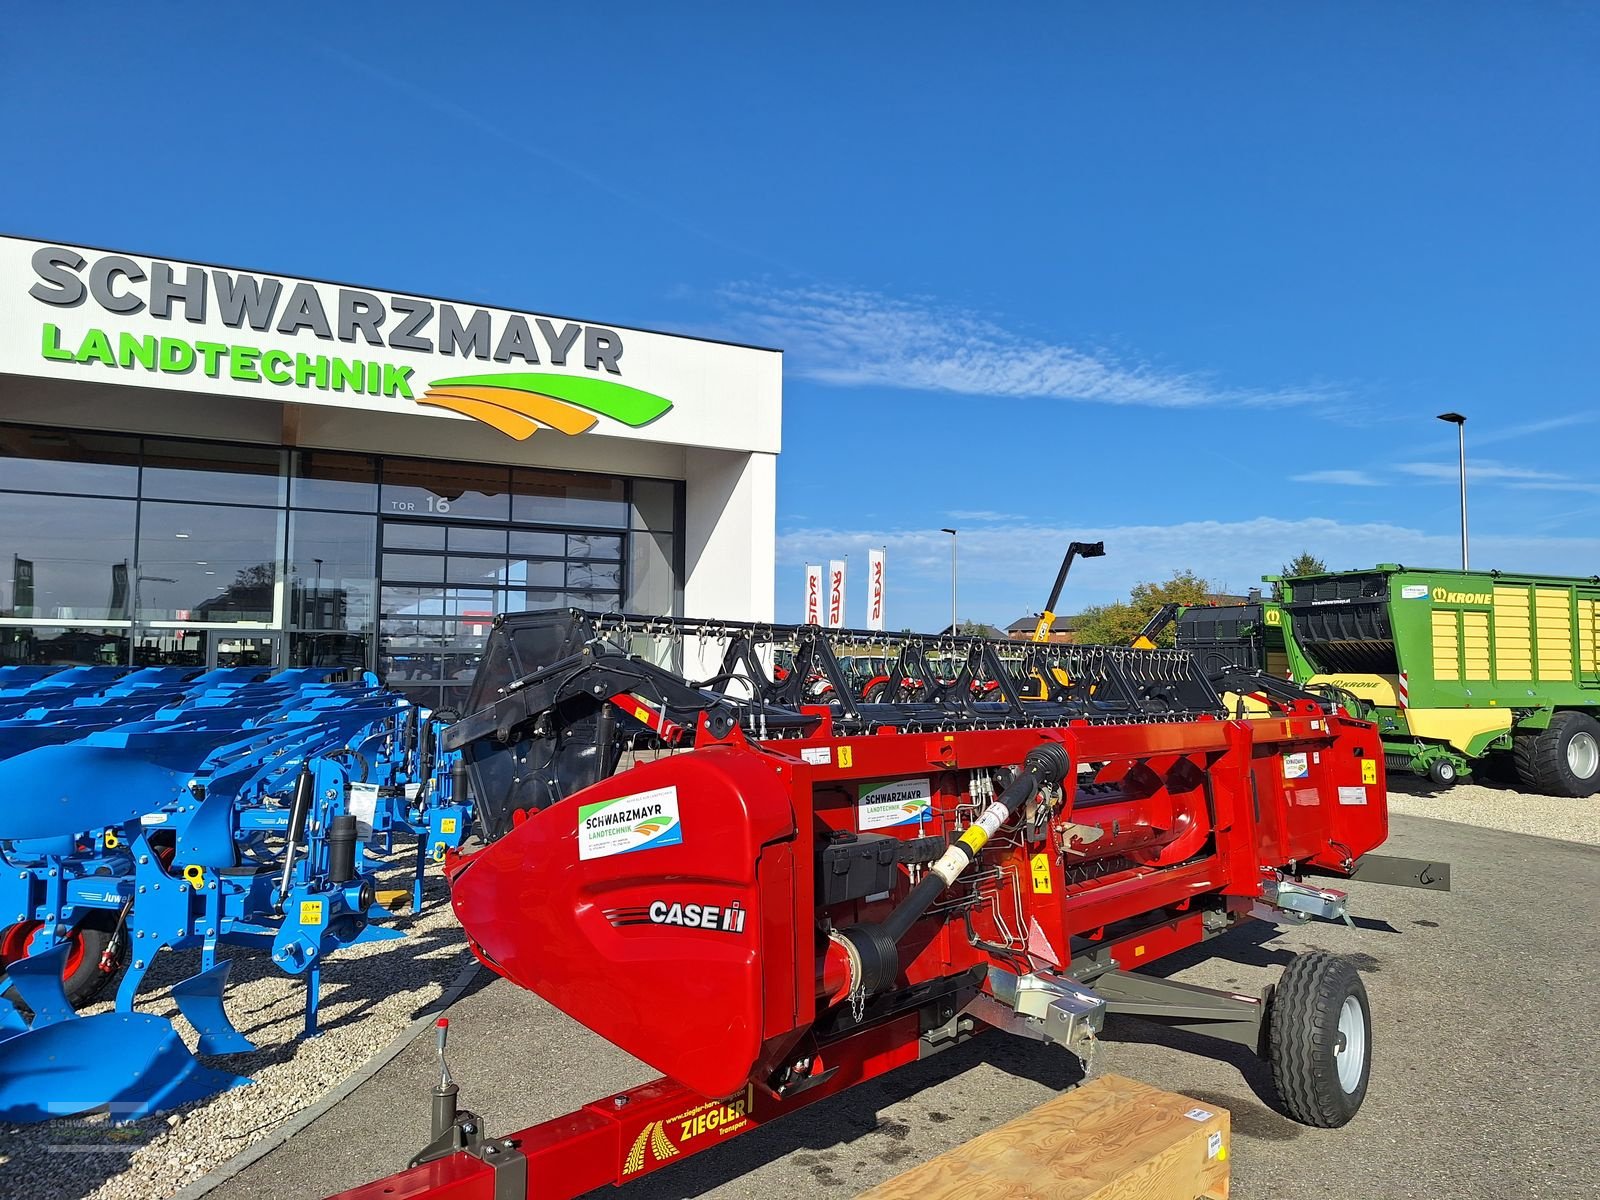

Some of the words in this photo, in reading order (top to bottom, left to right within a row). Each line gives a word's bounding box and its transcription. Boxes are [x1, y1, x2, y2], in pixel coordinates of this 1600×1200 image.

[28, 246, 624, 376] SCHWARZMAYR
[41, 322, 415, 400] LANDTECHNIK
[391, 501, 415, 511] TOR
[426, 496, 450, 513] 16
[809, 575, 818, 625] STEYR
[1446, 591, 1493, 605] KRONE
[1341, 681, 1381, 689] KRONE
[866, 790, 922, 805] SCHWARZMAYR
[586, 804, 662, 830] SCHWARZMAYR
[588, 825, 632, 840] LANDTECHNIK
[649, 900, 721, 929] CASE
[680, 1099, 746, 1142] ZIEGLER
[719, 1119, 747, 1136] Transport
